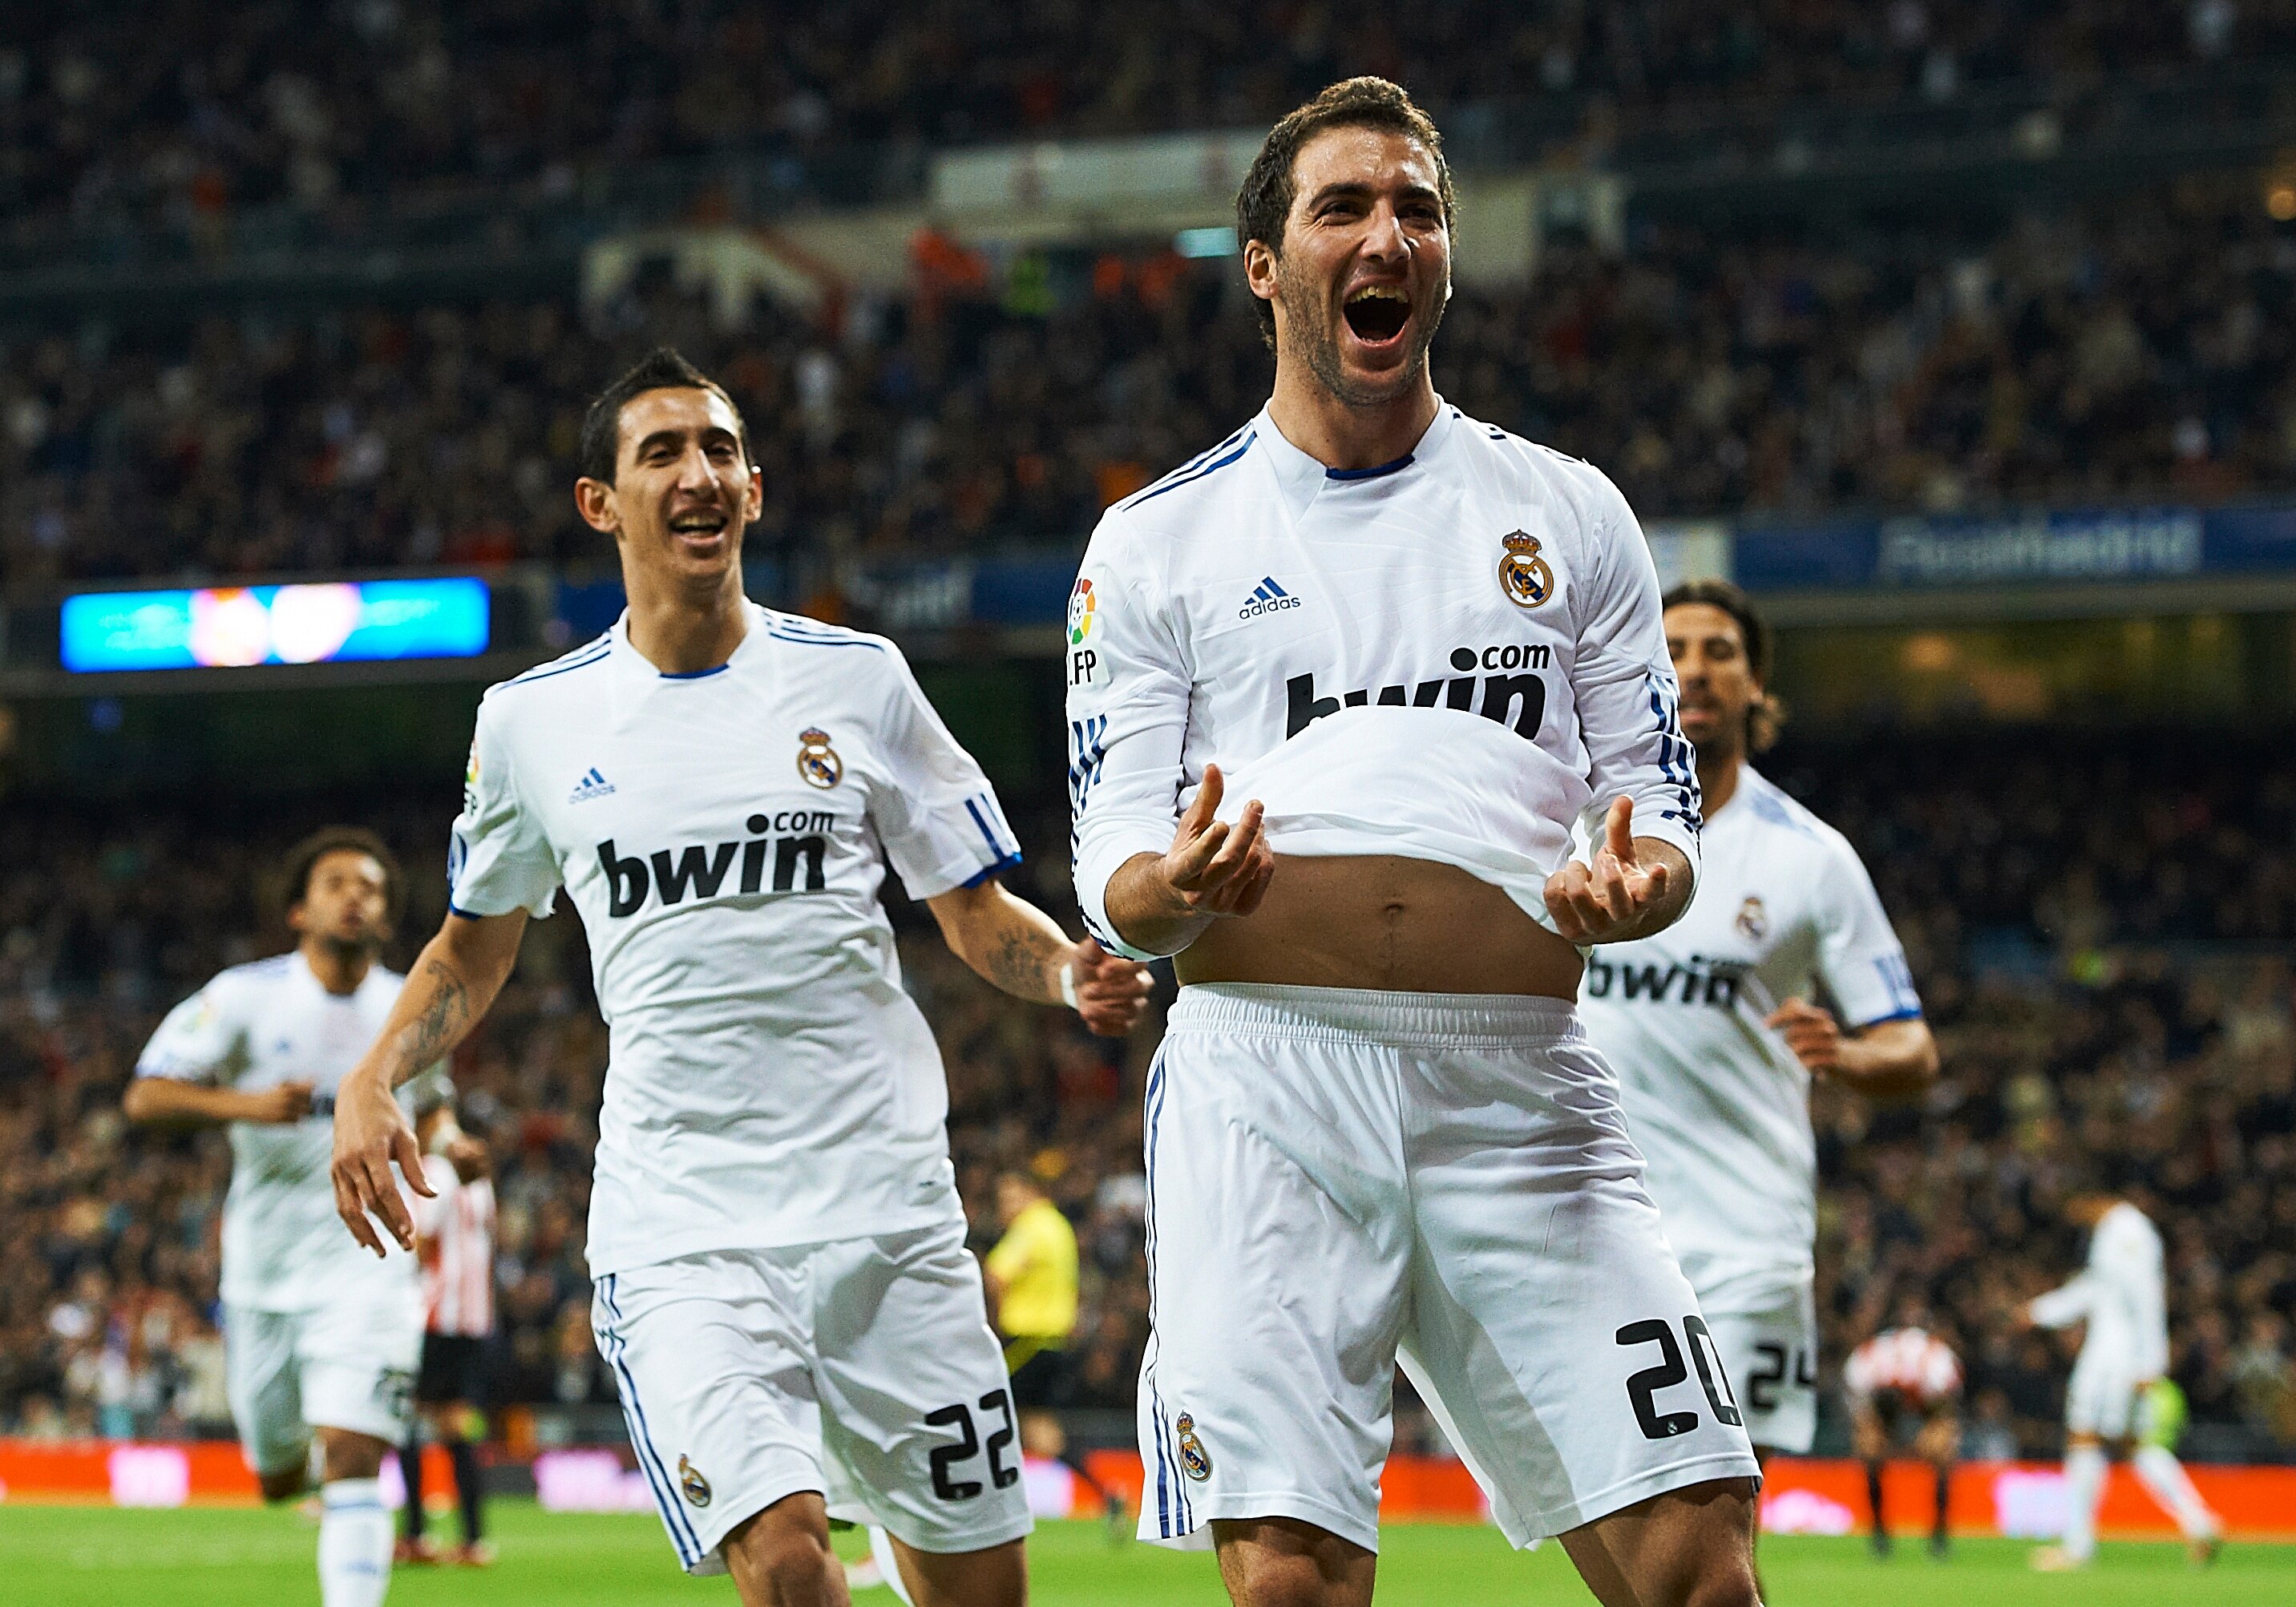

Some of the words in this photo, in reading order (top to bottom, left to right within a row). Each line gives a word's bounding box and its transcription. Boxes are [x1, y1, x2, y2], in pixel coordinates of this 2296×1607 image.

[1239, 597, 1300, 620] adidas
[1069, 649, 1097, 685] FP
[1482, 644, 1550, 670] com
[774, 812, 835, 832] com
[597, 814, 825, 918] bwin
[1615, 1315, 1743, 1439] 20
[925, 1389, 1018, 1500] 22
